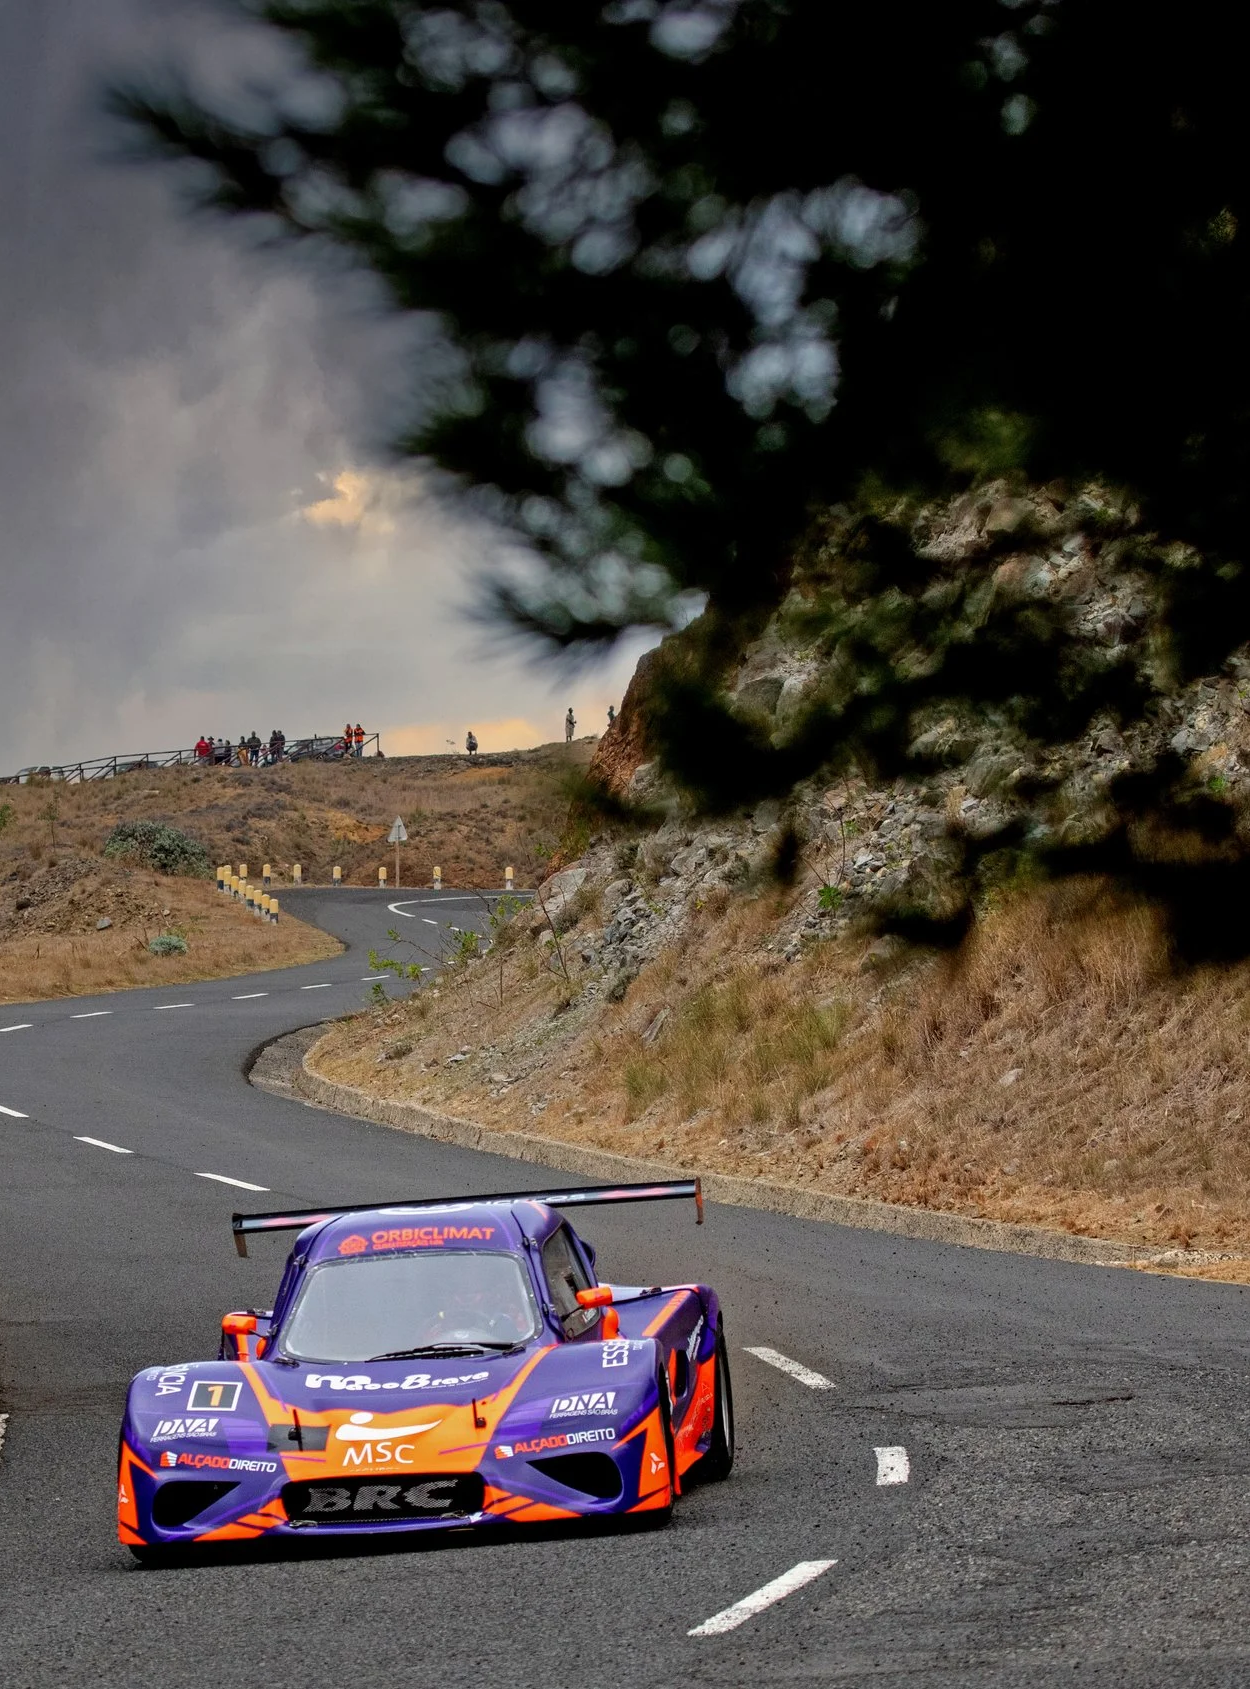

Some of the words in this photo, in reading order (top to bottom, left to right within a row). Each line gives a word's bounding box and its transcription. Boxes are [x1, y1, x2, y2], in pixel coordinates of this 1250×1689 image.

[371, 1226, 495, 1244] ORBICLIMAT
[207, 1384, 224, 1407] 1
[552, 1391, 616, 1414] DNA
[549, 1409, 587, 1419] FERRAGENS
[152, 1418, 220, 1437] DNA
[342, 1441, 415, 1467] MSC
[302, 1479, 459, 1513] BRC
